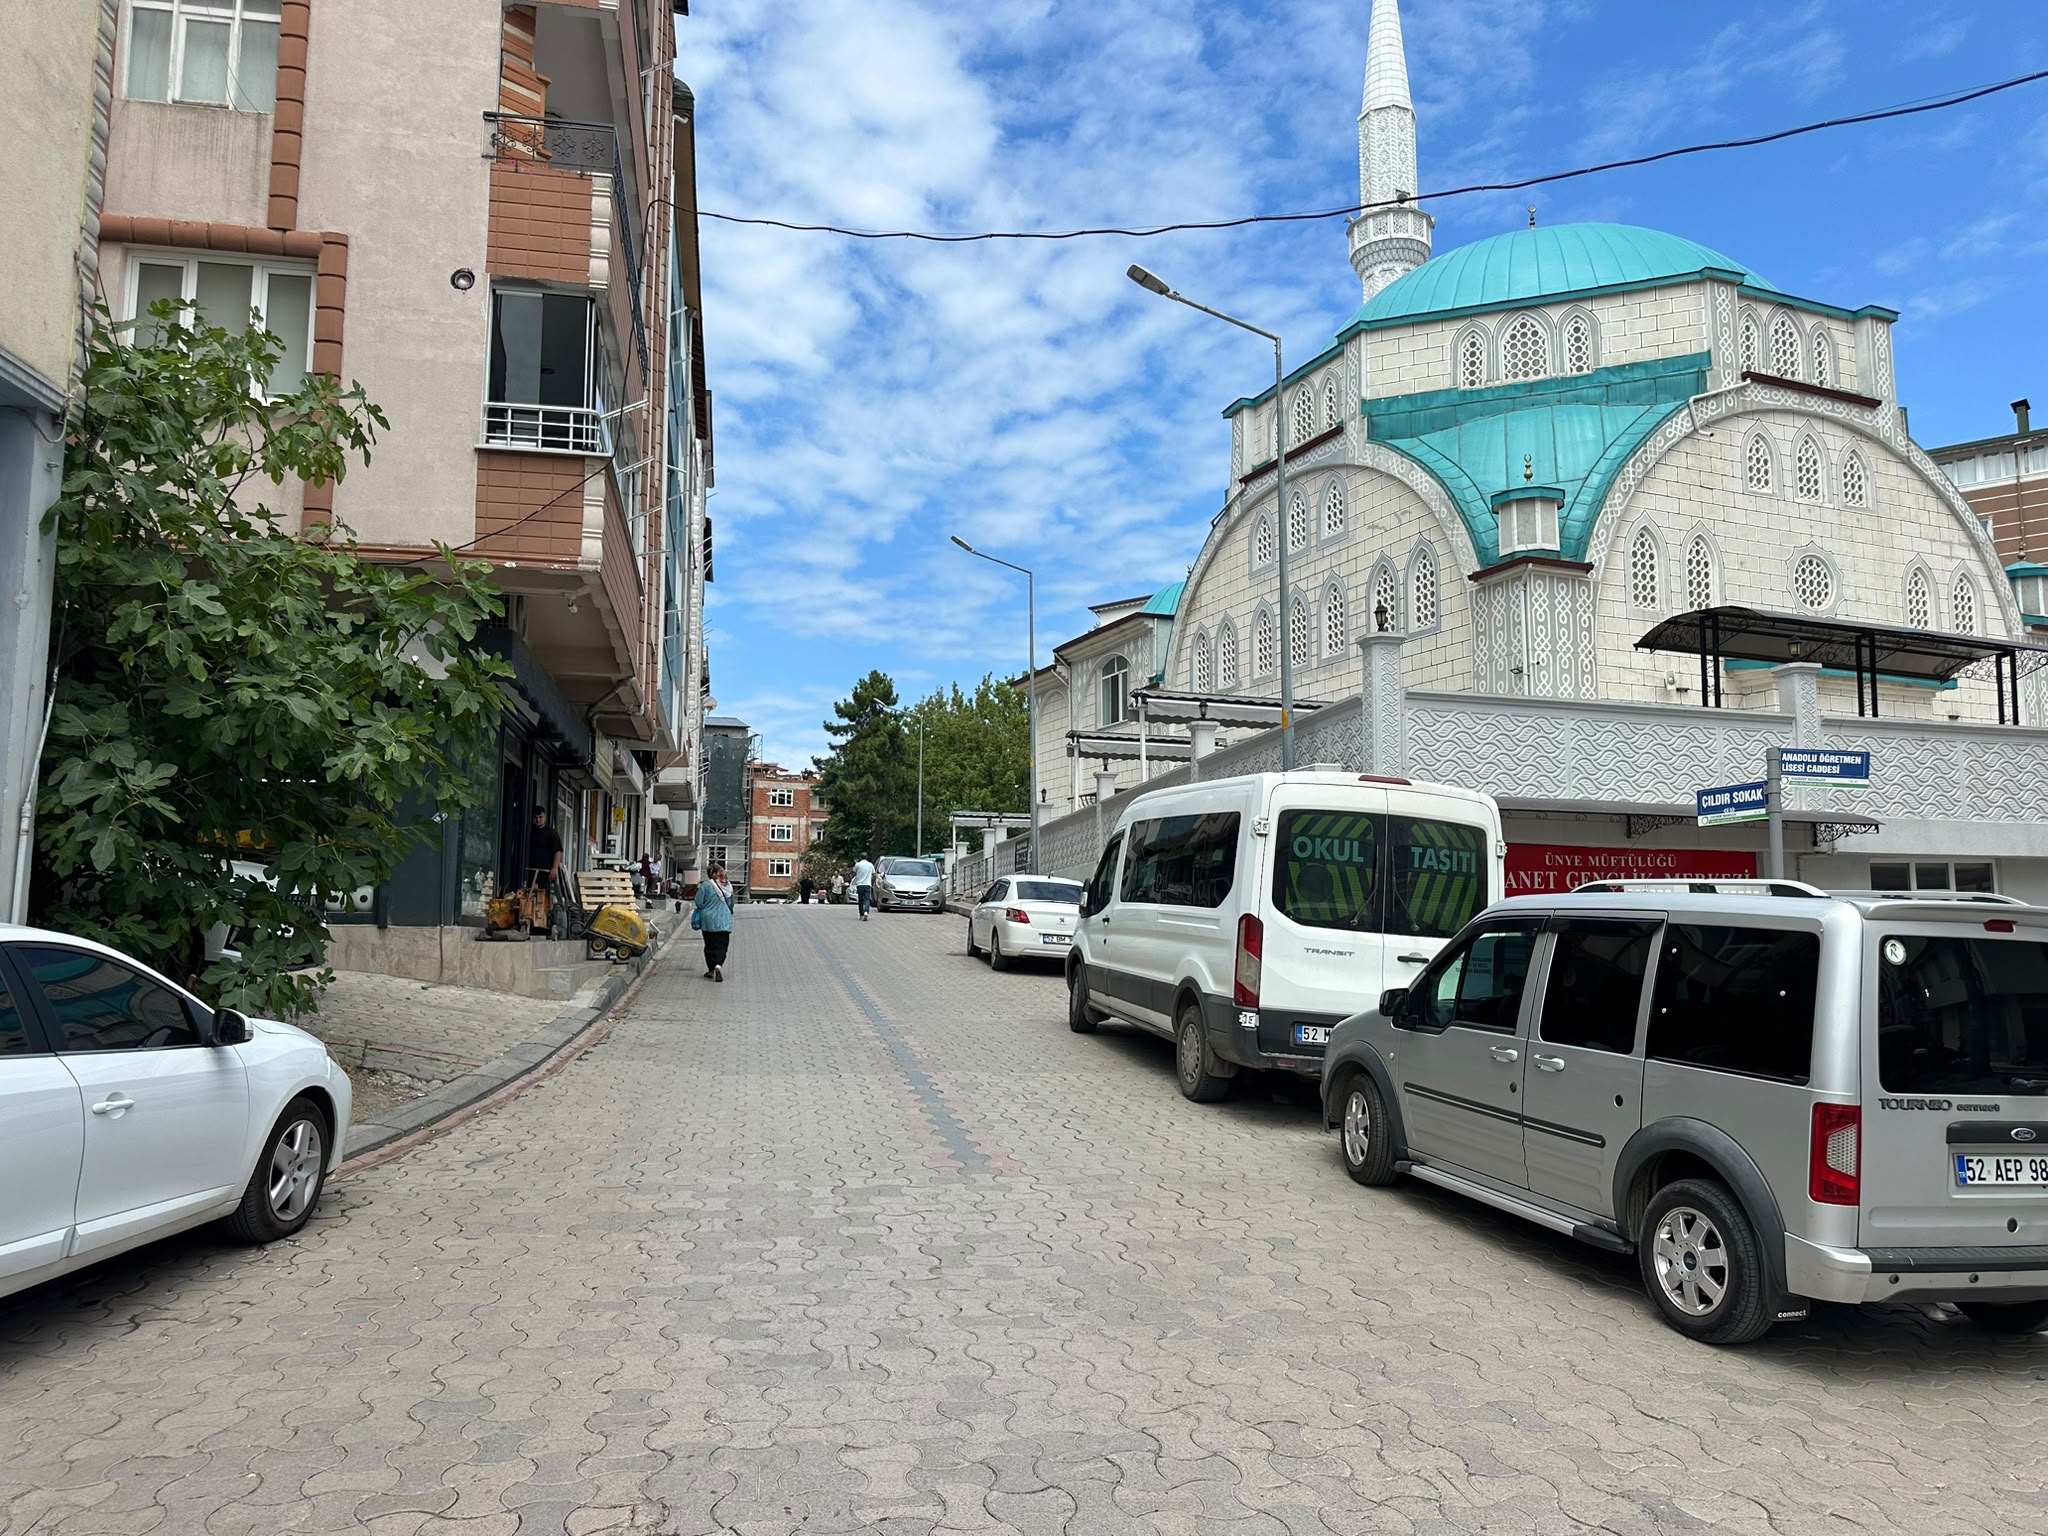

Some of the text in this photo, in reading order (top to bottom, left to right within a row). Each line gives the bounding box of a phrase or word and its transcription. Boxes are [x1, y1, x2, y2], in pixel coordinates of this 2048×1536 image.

[1782, 753, 1862, 765] ANADOLU ÖĞRETMEN
[1782, 763, 1840, 774] LİSESİ CADDESİ
[1702, 788, 1763, 808] ÇILDIR SOKAK
[1292, 836, 1364, 863] OKUL
[1411, 846, 1476, 874] TAŞITI
[1545, 852, 1677, 868] ÜNYE MÜFTÜLÜĞÜ
[1304, 947, 1355, 957] TRANSIT
[1303, 1027, 1318, 1041] 52
[1878, 1098, 2001, 1112] TOURNEO connect
[1966, 1158, 2048, 1182] 52 AEP 98
[1777, 1309, 1807, 1318] connect
